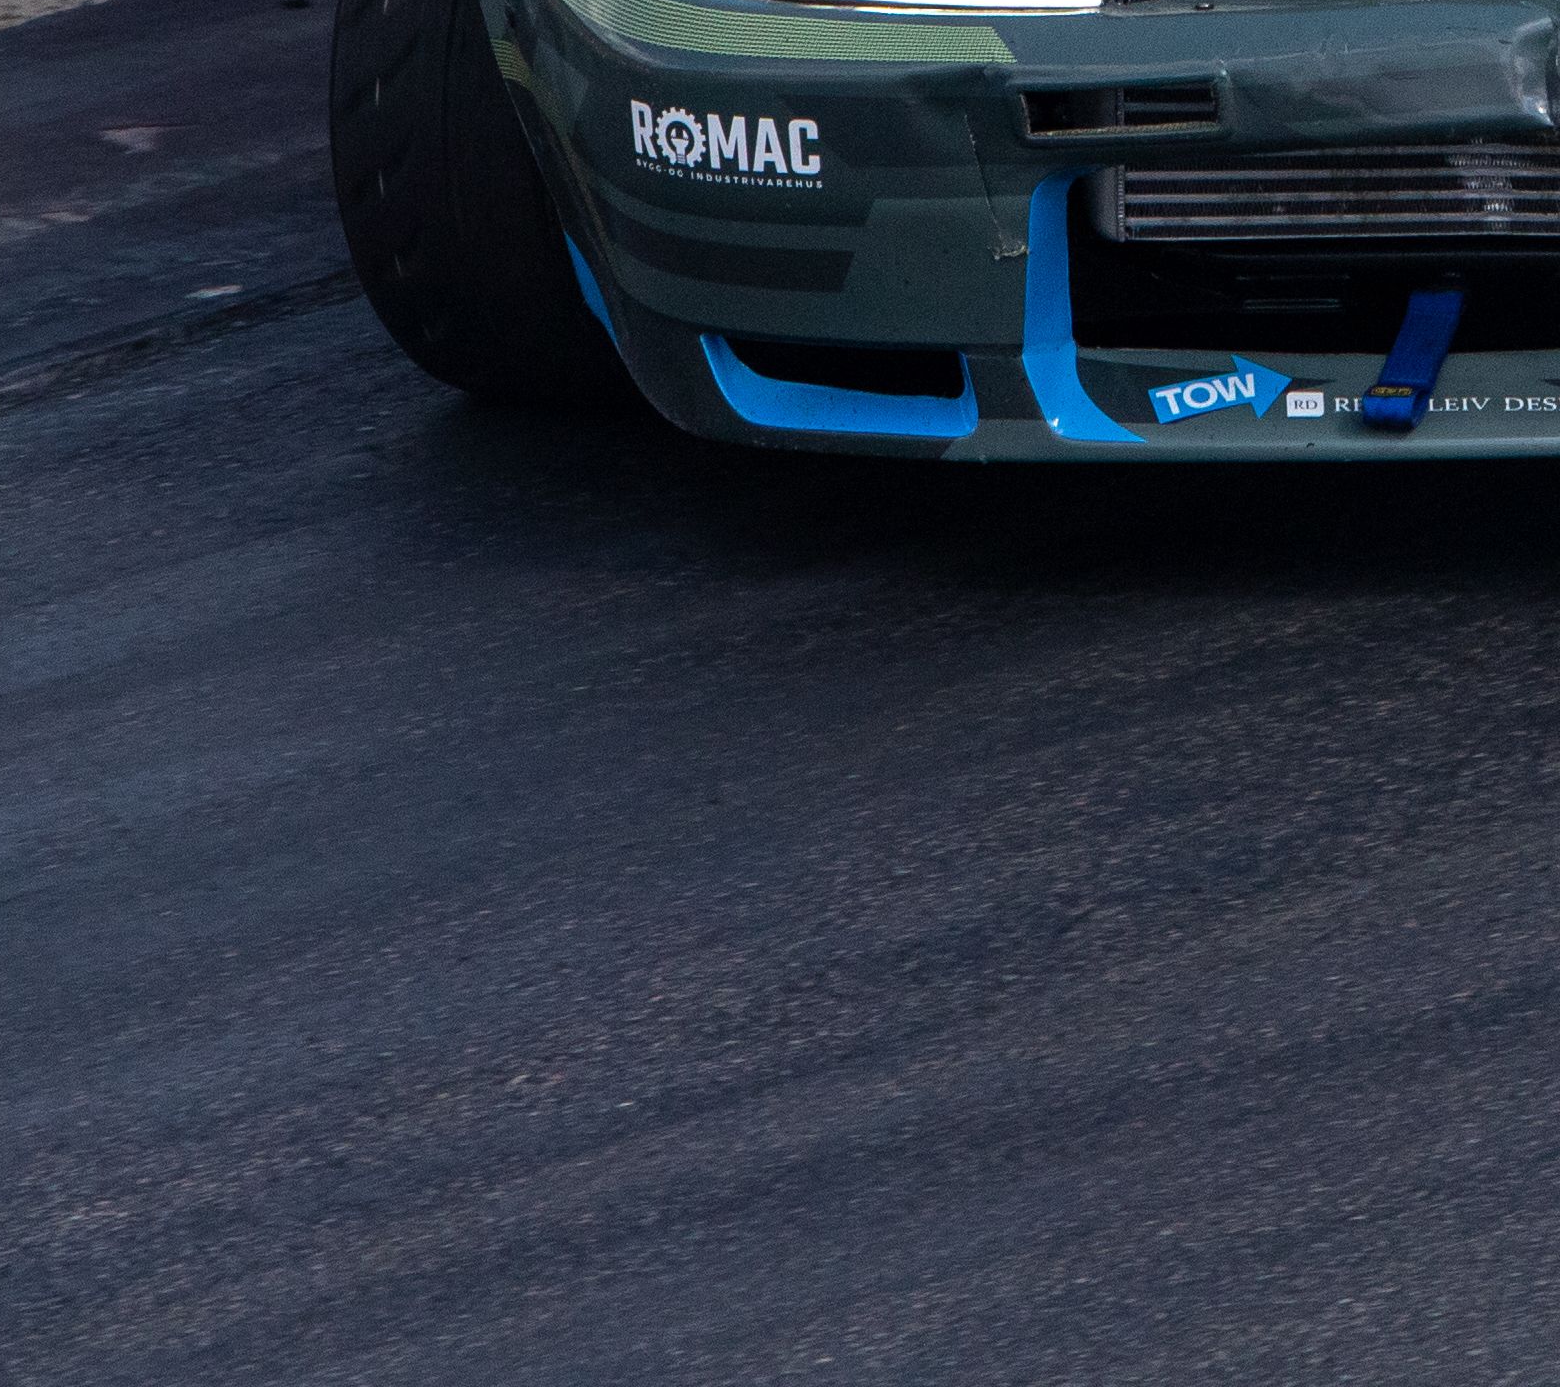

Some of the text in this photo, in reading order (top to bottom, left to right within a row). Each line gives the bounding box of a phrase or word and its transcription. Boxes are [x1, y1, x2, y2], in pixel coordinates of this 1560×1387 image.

[630, 98, 821, 175] ROMAC
[690, 171, 823, 189] INDUSTRIVAREHUS
[1154, 373, 1257, 415] TOW
[1293, 399, 1319, 411] RD
